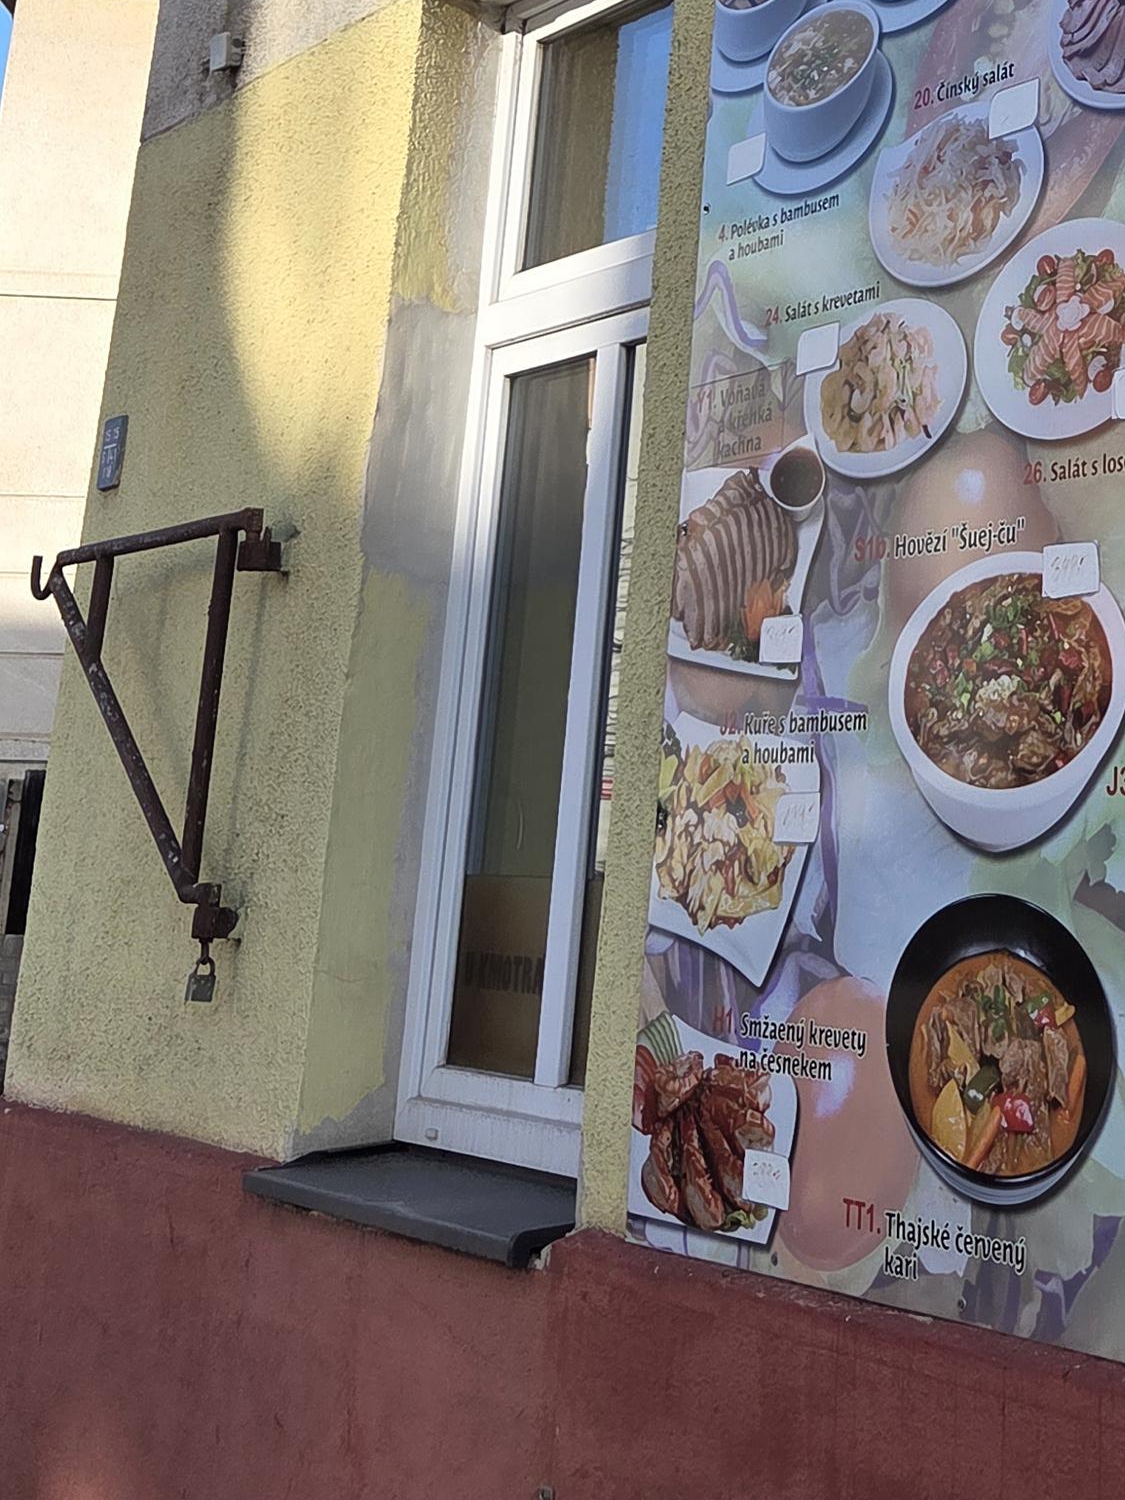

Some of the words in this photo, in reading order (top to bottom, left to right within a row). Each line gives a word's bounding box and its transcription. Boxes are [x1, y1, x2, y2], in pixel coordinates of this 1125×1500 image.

[914, 87, 934, 110] 20.
[937, 71, 980, 101] Čínský
[982, 61, 1015, 87] salát
[730, 216, 770, 241] Polévka
[772, 214, 778, 227] s
[780, 194, 840, 224] bambusem
[728, 248, 735, 261] a
[737, 229, 784, 259] houbami
[785, 299, 812, 323] Salát
[814, 303, 820, 315] s
[822, 281, 880, 313] krevetami
[718, 436, 762, 459] kachna
[1023, 461, 1047, 485] 26.
[1050, 457, 1087, 482] Salát
[1091, 459, 1098, 475] s
[894, 527, 947, 559] Hovězí
[745, 712, 776, 735] Kuře
[779, 717, 786, 734] s
[789, 710, 867, 734] bambusem
[742, 748, 749, 764] a
[754, 741, 814, 764] houbami
[741, 1014, 805, 1048] Smžaený
[809, 1021, 866, 1057] krevety
[740, 1050, 756, 1069] na
[760, 1048, 832, 1081] česnekem
[843, 1198, 881, 1234] TT1.
[885, 1212, 950, 1250] Thajské
[955, 1226, 1026, 1273] červený
[884, 1247, 917, 1280] kari
